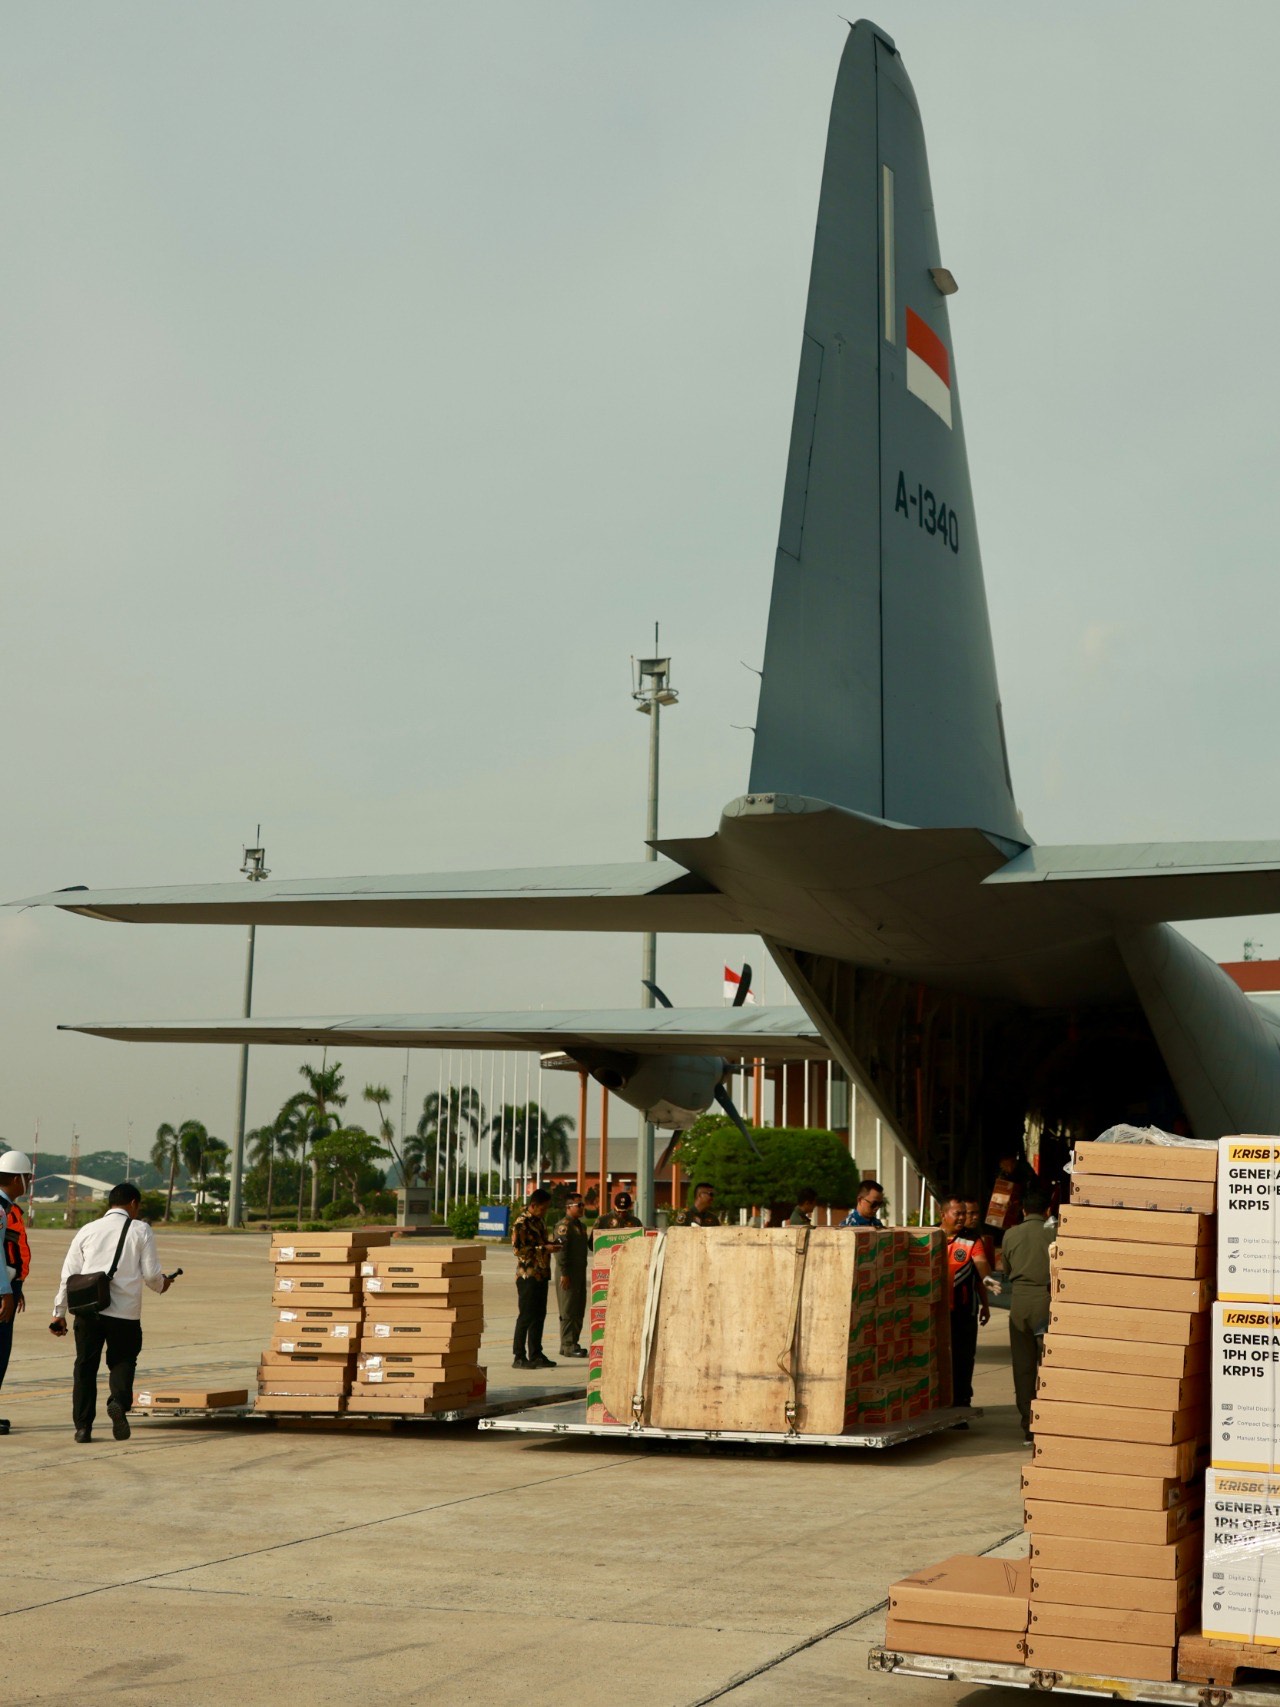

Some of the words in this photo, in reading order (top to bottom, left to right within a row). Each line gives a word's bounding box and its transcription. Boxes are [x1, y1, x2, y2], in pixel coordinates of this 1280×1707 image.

[895, 470, 958, 554] A-1340
[1229, 1184, 1252, 1195] 1PH
[1229, 1199, 1270, 1211] KRP15
[1223, 1349, 1246, 1360] 1PH
[1223, 1365, 1264, 1378] KRP15
[1218, 1480, 1280, 1494] KRISBOW
[1214, 1517, 1239, 1529] 1PH
[1247, 1607, 1269, 1615] Srting
